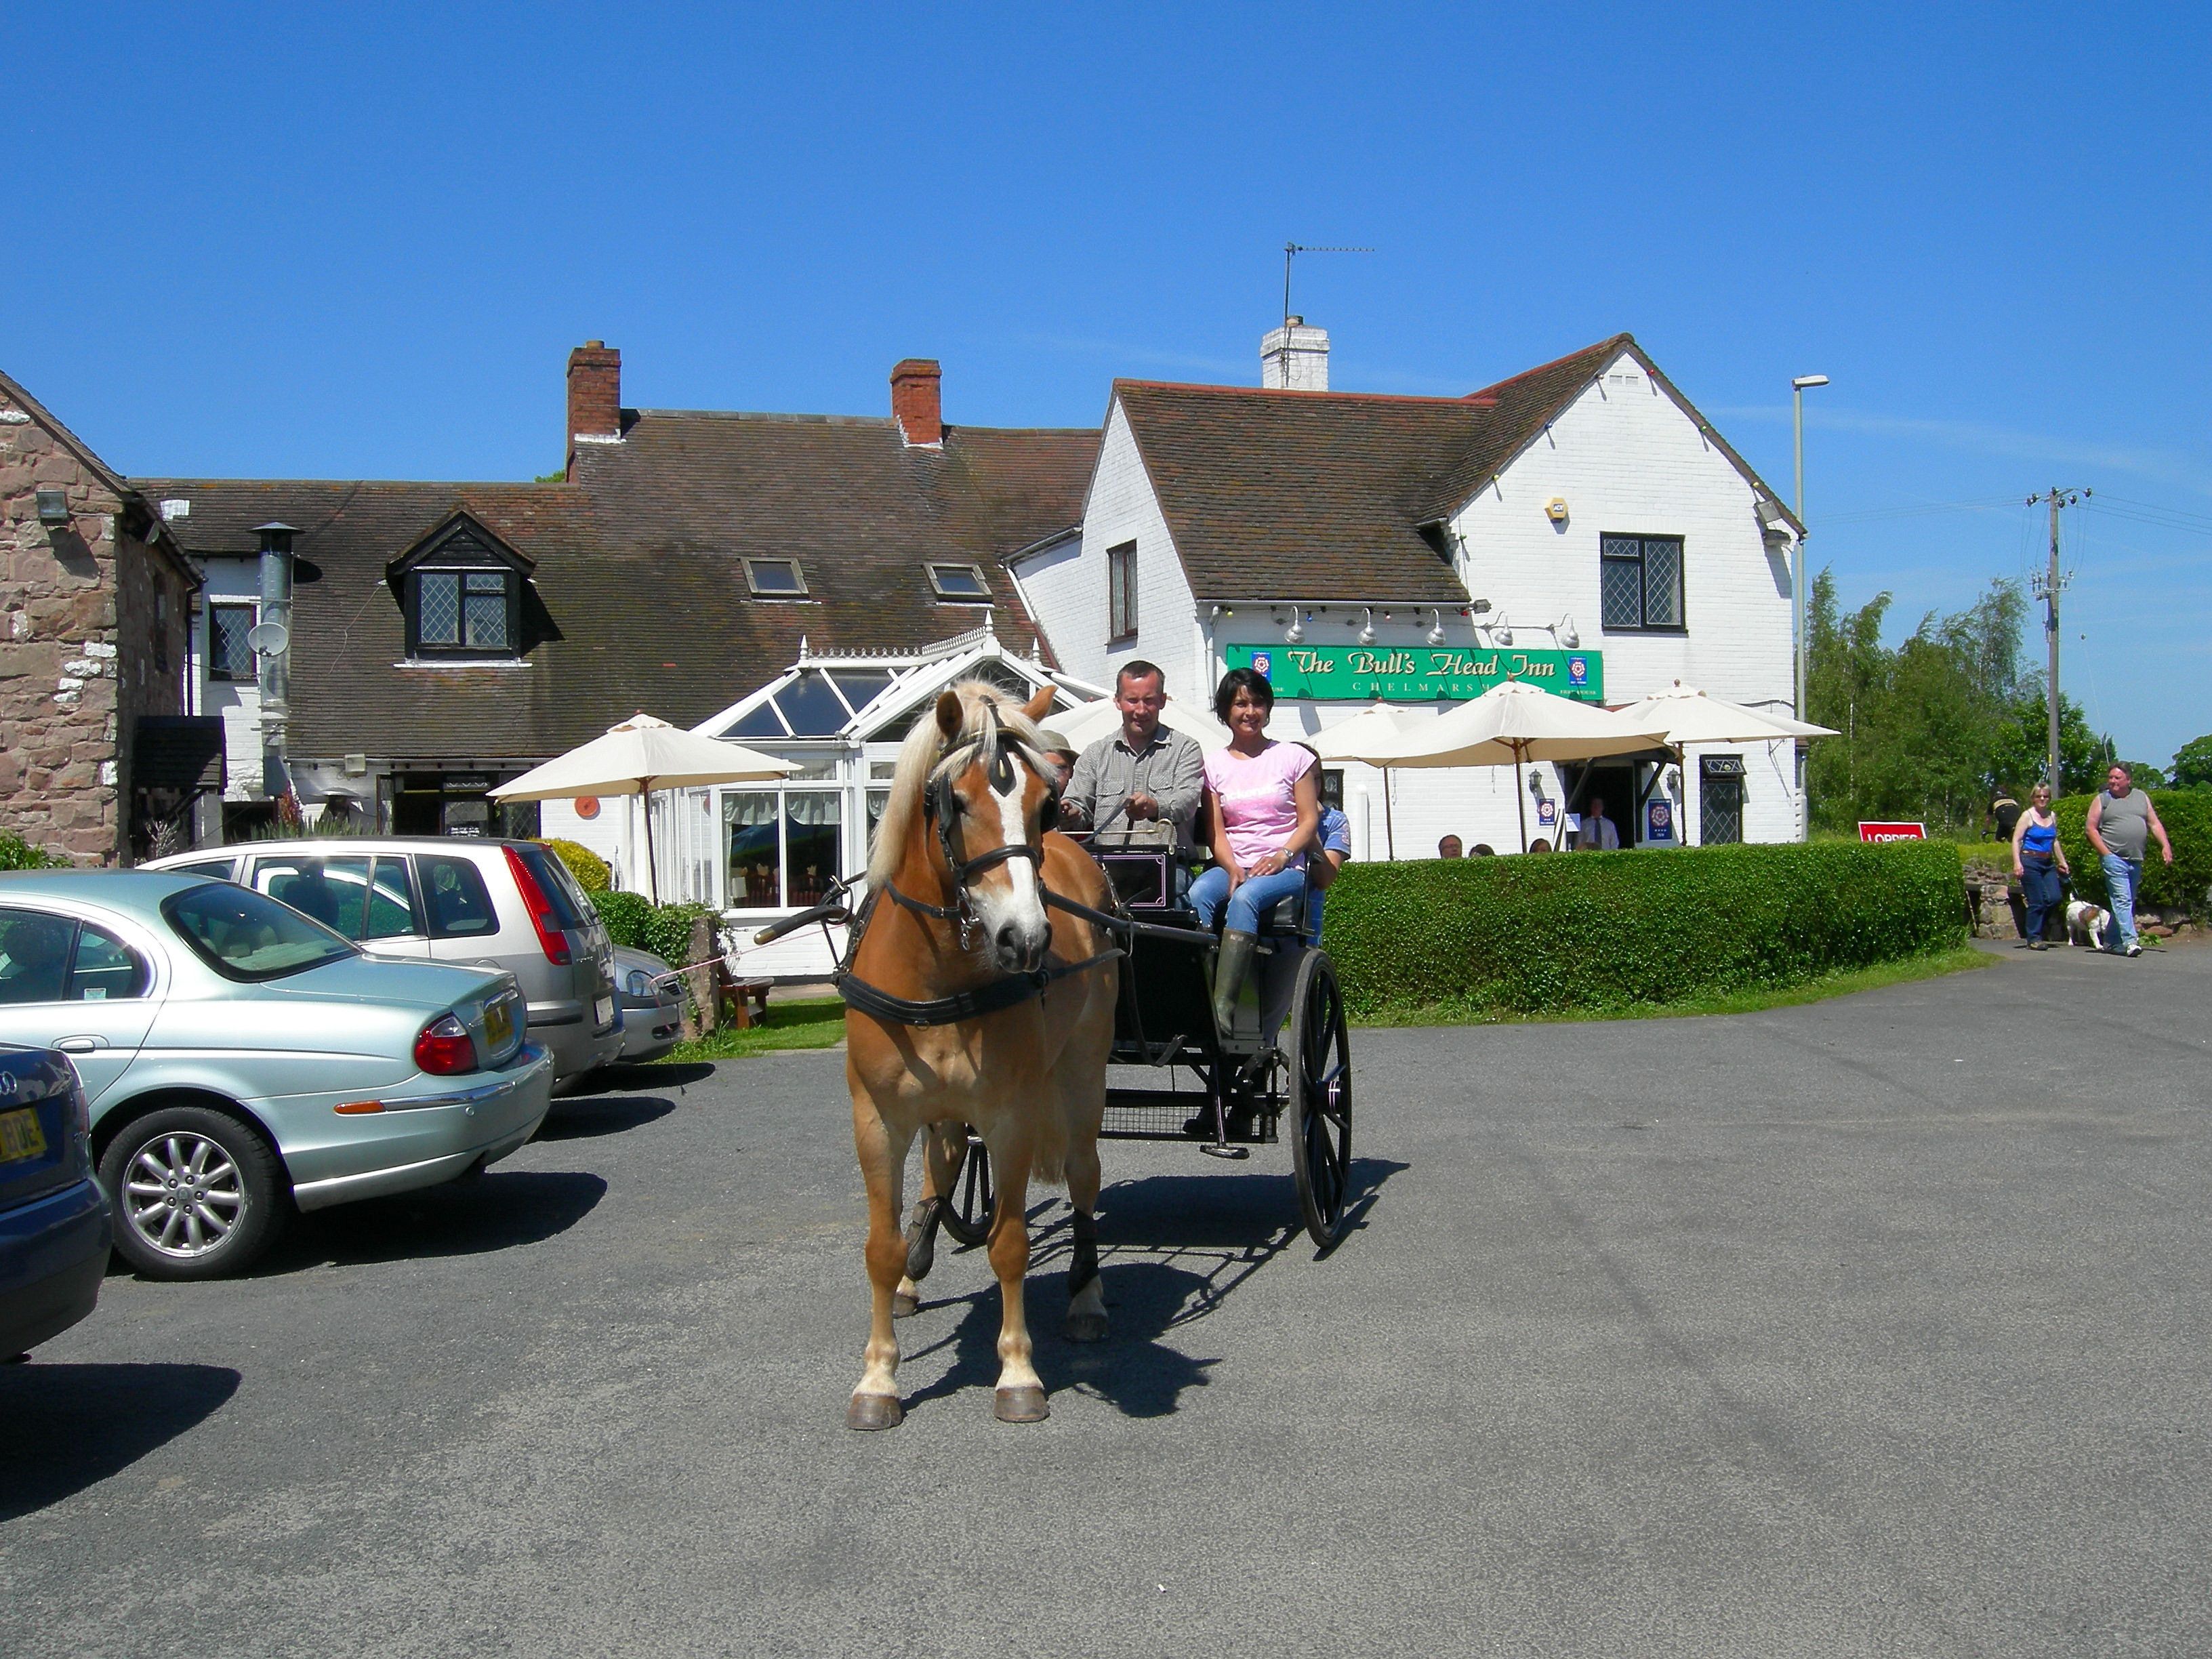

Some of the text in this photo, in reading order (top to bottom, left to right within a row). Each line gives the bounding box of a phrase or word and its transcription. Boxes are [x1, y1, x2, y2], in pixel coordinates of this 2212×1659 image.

[1288, 651, 1556, 676] The Bull's Head Inn
